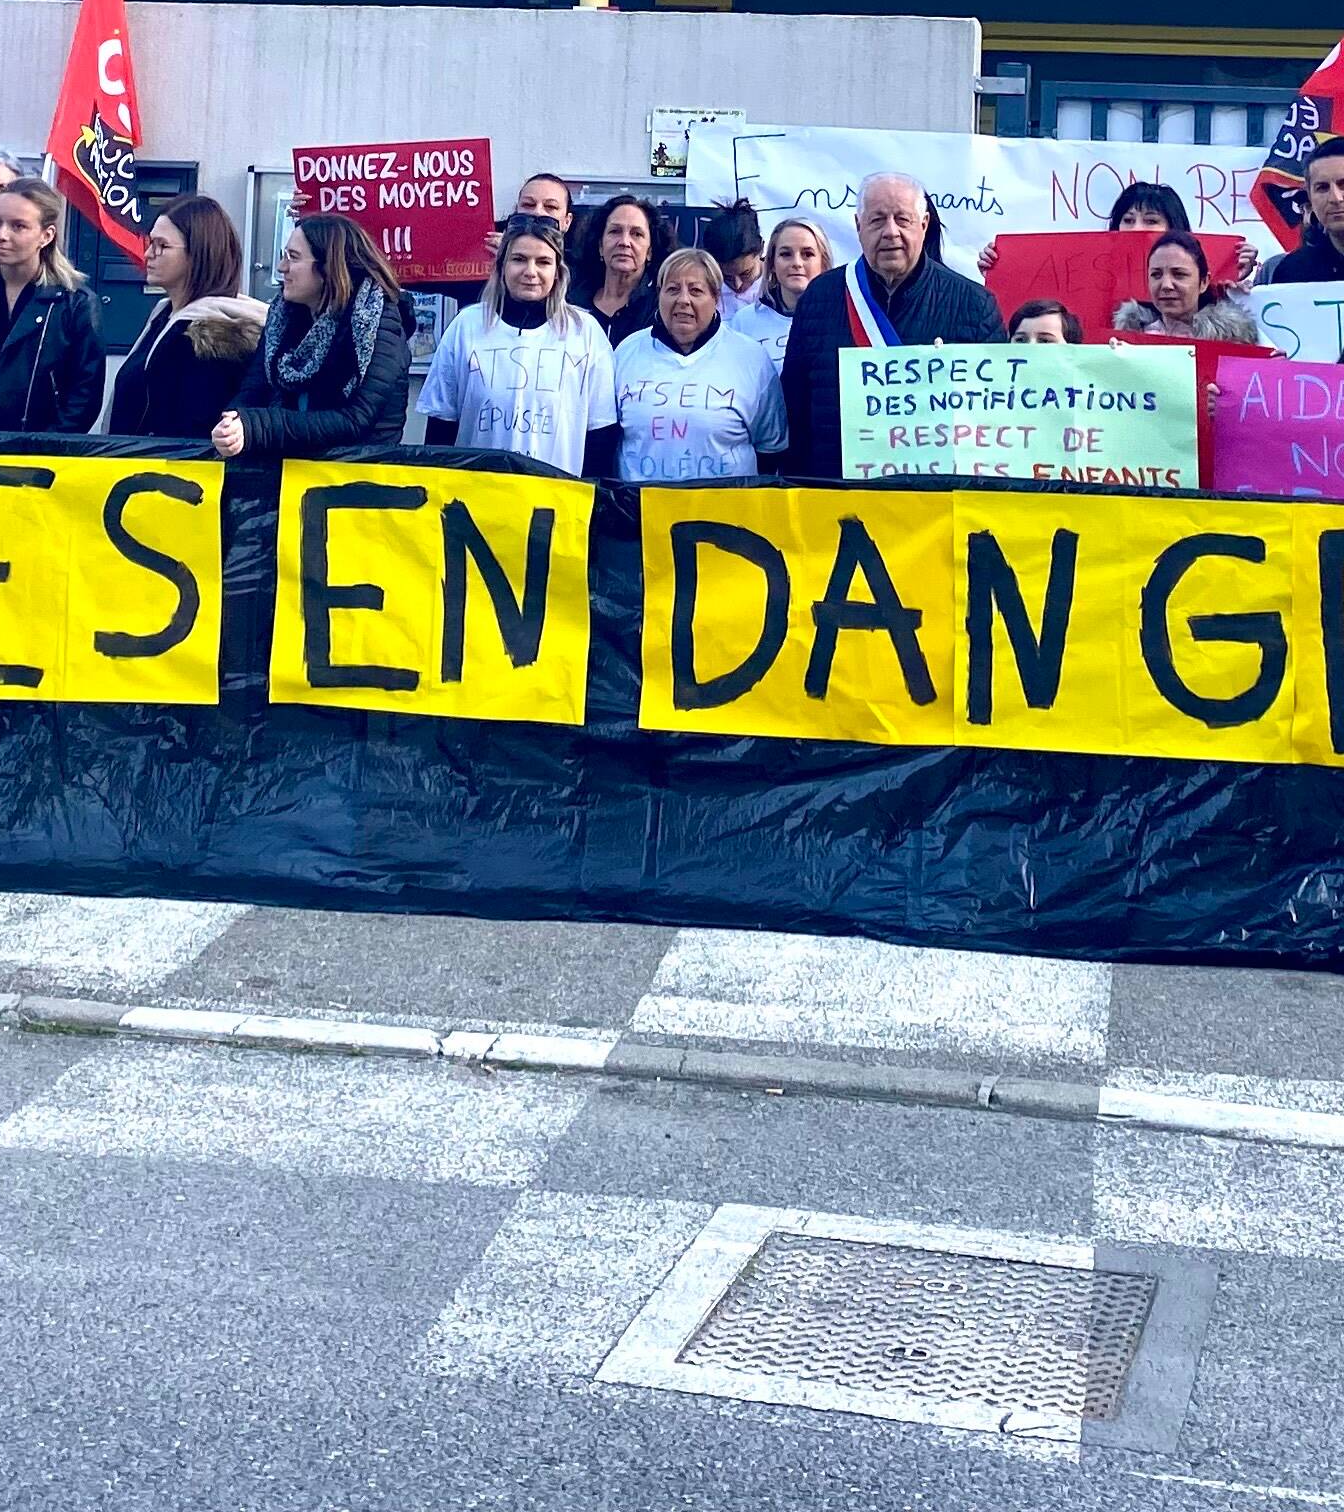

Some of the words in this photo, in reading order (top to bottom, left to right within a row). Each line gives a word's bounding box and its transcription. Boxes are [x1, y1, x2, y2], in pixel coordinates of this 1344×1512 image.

[319, 185, 368, 213] DES
[378, 180, 482, 210] MOYENS
[468, 346, 590, 397] ATSEM
[861, 358, 1028, 386] RESPECT
[619, 380, 735, 410] ATSEM
[867, 394, 917, 416] DES
[929, 383, 1158, 412] NOTIFICATIONS
[652, 416, 689, 441] EN
[889, 423, 1038, 450] RESPECT
[1062, 426, 1105, 454] DE
[303, 483, 555, 690] EN
